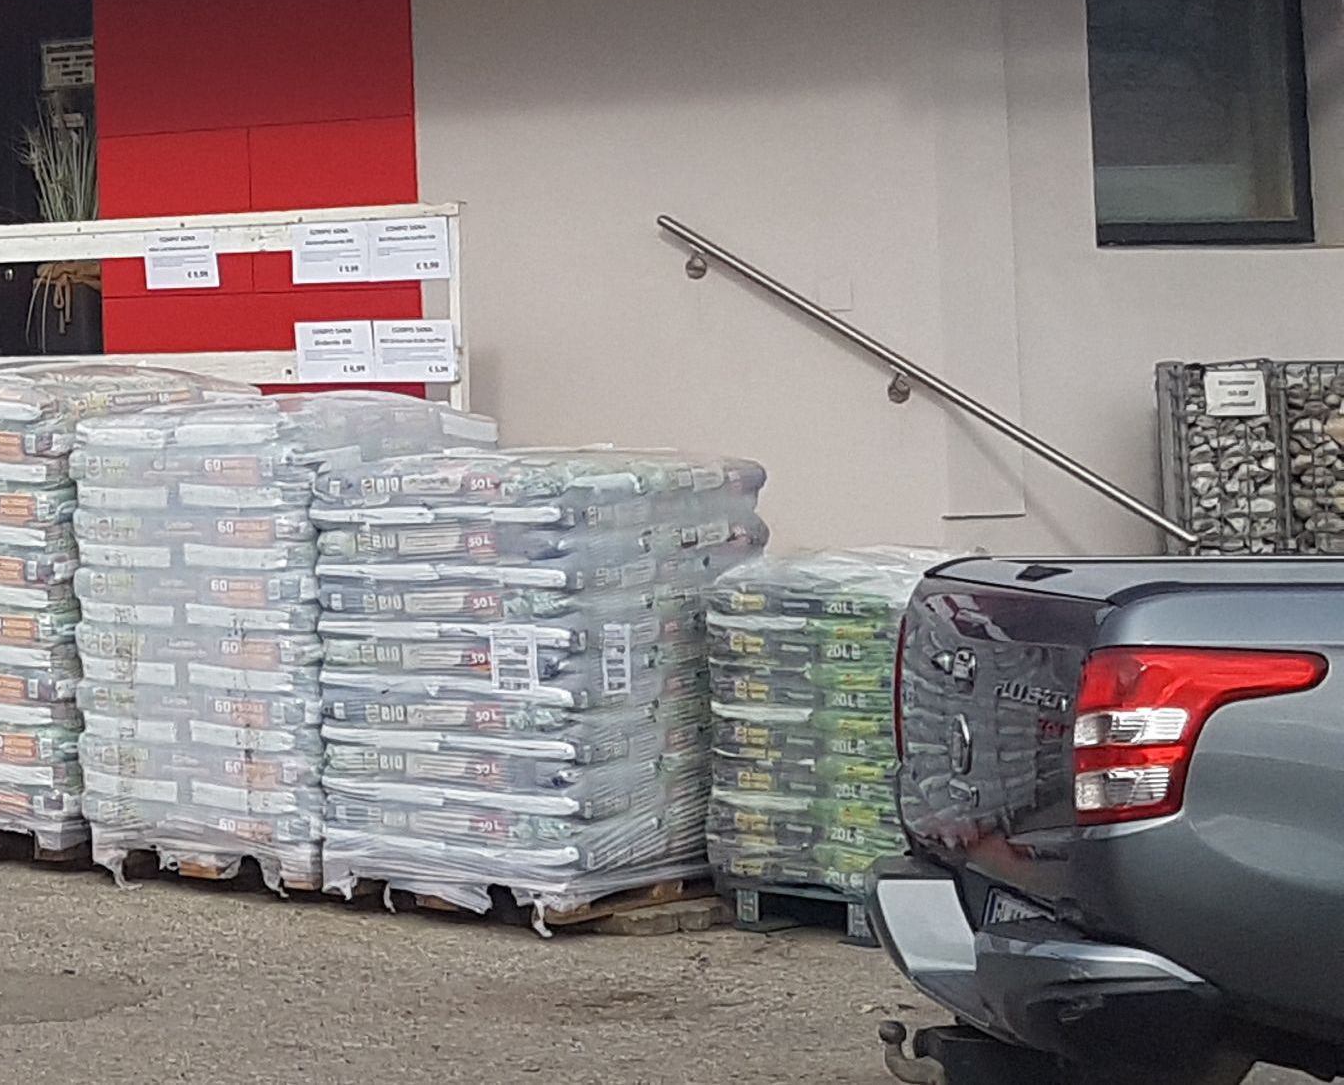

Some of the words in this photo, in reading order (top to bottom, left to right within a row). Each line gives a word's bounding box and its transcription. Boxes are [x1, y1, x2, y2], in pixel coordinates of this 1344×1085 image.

[203, 458, 222, 472] 60
[376, 476, 400, 492] BIO
[217, 521, 235, 533] 60
[210, 579, 228, 592] 60
[377, 594, 403, 610] BIO
[220, 640, 238, 654] 60
[375, 645, 400, 662] BIO
[214, 701, 231, 713] 60
[381, 706, 405, 721] BIO
[379, 754, 404, 769] BIO
[218, 818, 236, 831] 60
